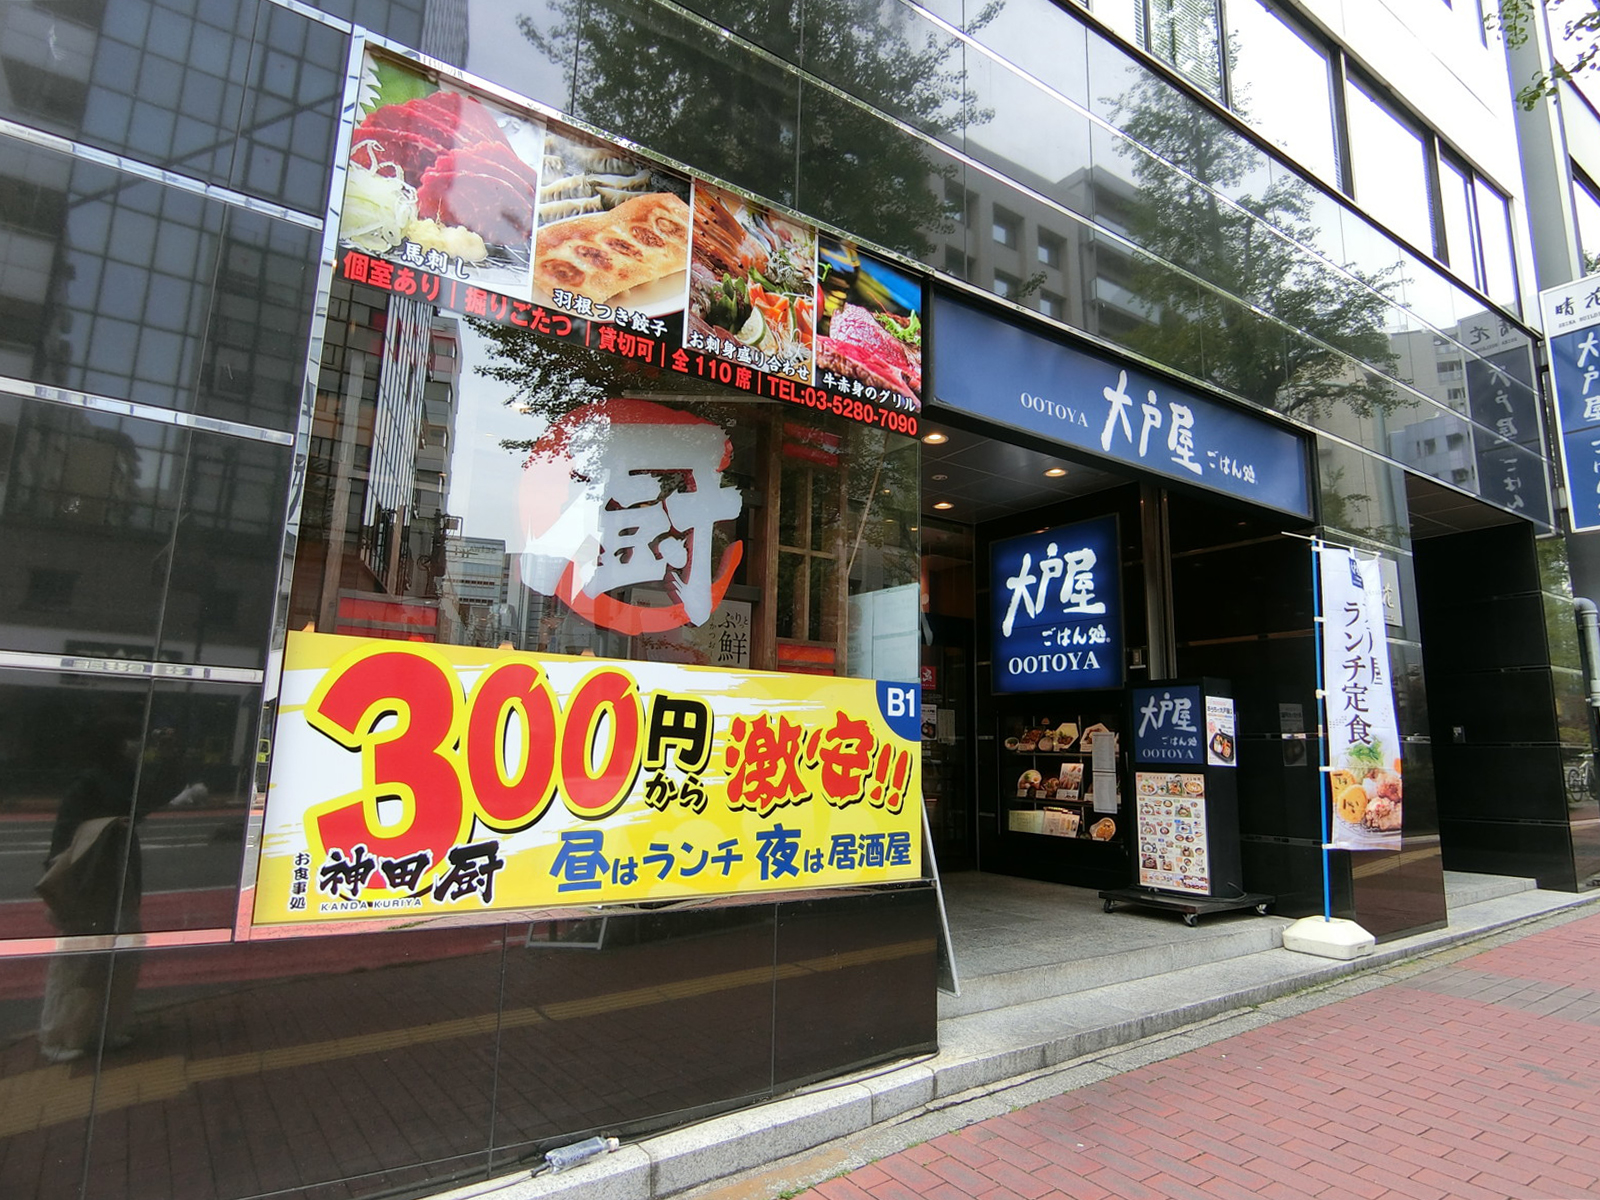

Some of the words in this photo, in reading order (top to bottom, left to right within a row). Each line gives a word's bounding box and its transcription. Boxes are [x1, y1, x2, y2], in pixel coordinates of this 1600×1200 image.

[401, 242, 470, 280] 馬刺し
[553, 289, 668, 338] 羽根つき餃子
[343, 251, 440, 301] 個室あり
[465, 286, 573, 337] 掘りごたつ
[598, 325, 654, 363] 貸切可
[766, 376, 918, 437] TEL:03-5280-7090
[688, 330, 812, 382] お刺身盛り合わせ
[822, 372, 917, 413] 牛赤身のグリル
[1577, 332, 1600, 423] 大戸屋
[1020, 392, 1089, 428] OOTOYA
[1101, 369, 1203, 475] 大戸屋
[1206, 450, 1257, 484] ごはん処
[1002, 542, 1106, 638] 大戸屋
[1042, 624, 1107, 647] ごはん処
[1008, 651, 1101, 675] OOTOYA
[1342, 601, 1373, 746] ランチ定食
[886, 687, 916, 718] B1
[1138, 692, 1198, 738] 大戸屋
[1142, 749, 1195, 760] OOTOYA
[1161, 737, 1198, 747] ごはん処
[645, 772, 708, 812] から
[290, 852, 311, 910] お食事処
[549, 830, 743, 893] 昼はランチ
[756, 823, 912, 881] 夜は居酒屋
[321, 901, 368, 911] KANDA
[374, 897, 422, 908] KURIYA
